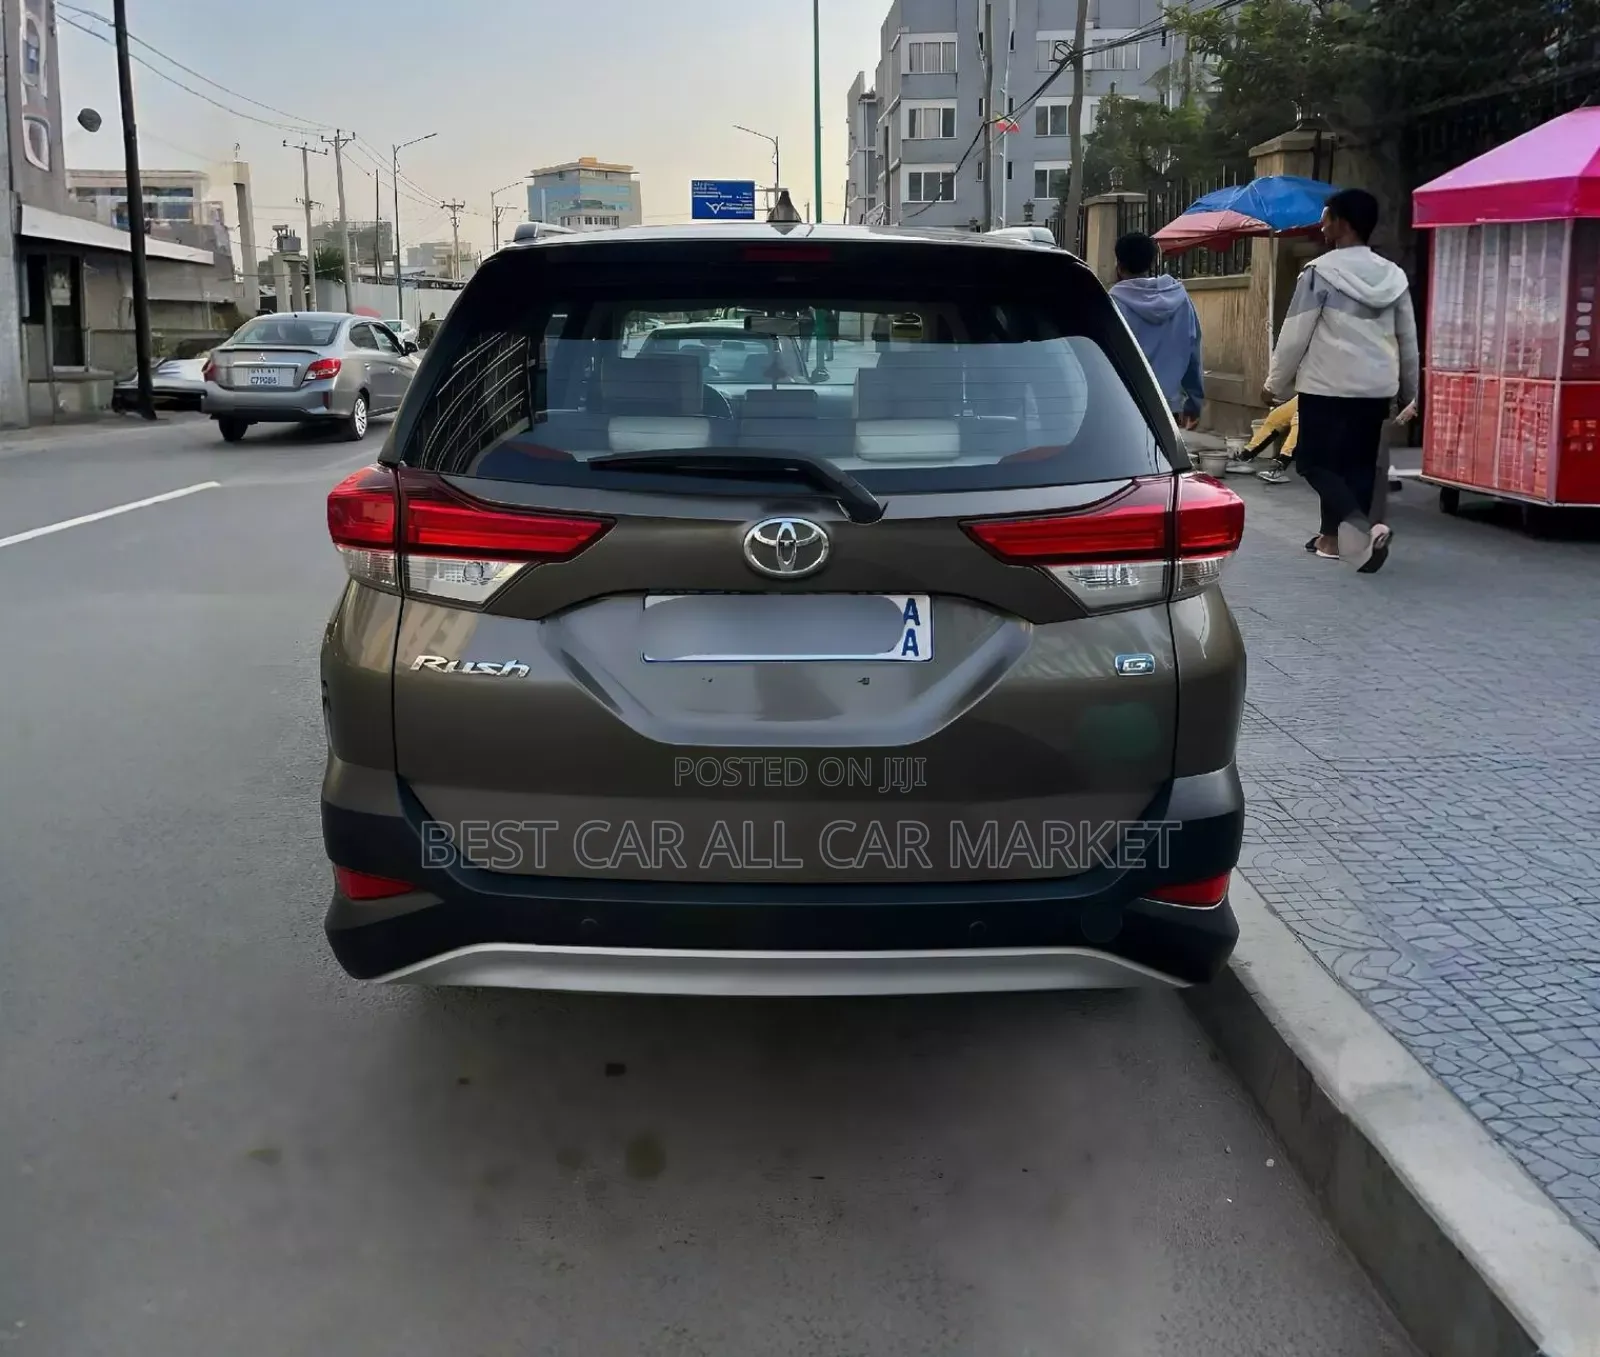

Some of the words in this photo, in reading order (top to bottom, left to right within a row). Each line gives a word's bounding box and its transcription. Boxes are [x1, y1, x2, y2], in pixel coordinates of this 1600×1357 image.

[902, 597, 920, 626] A
[901, 628, 919, 657] A
[410, 655, 530, 678] Rush
